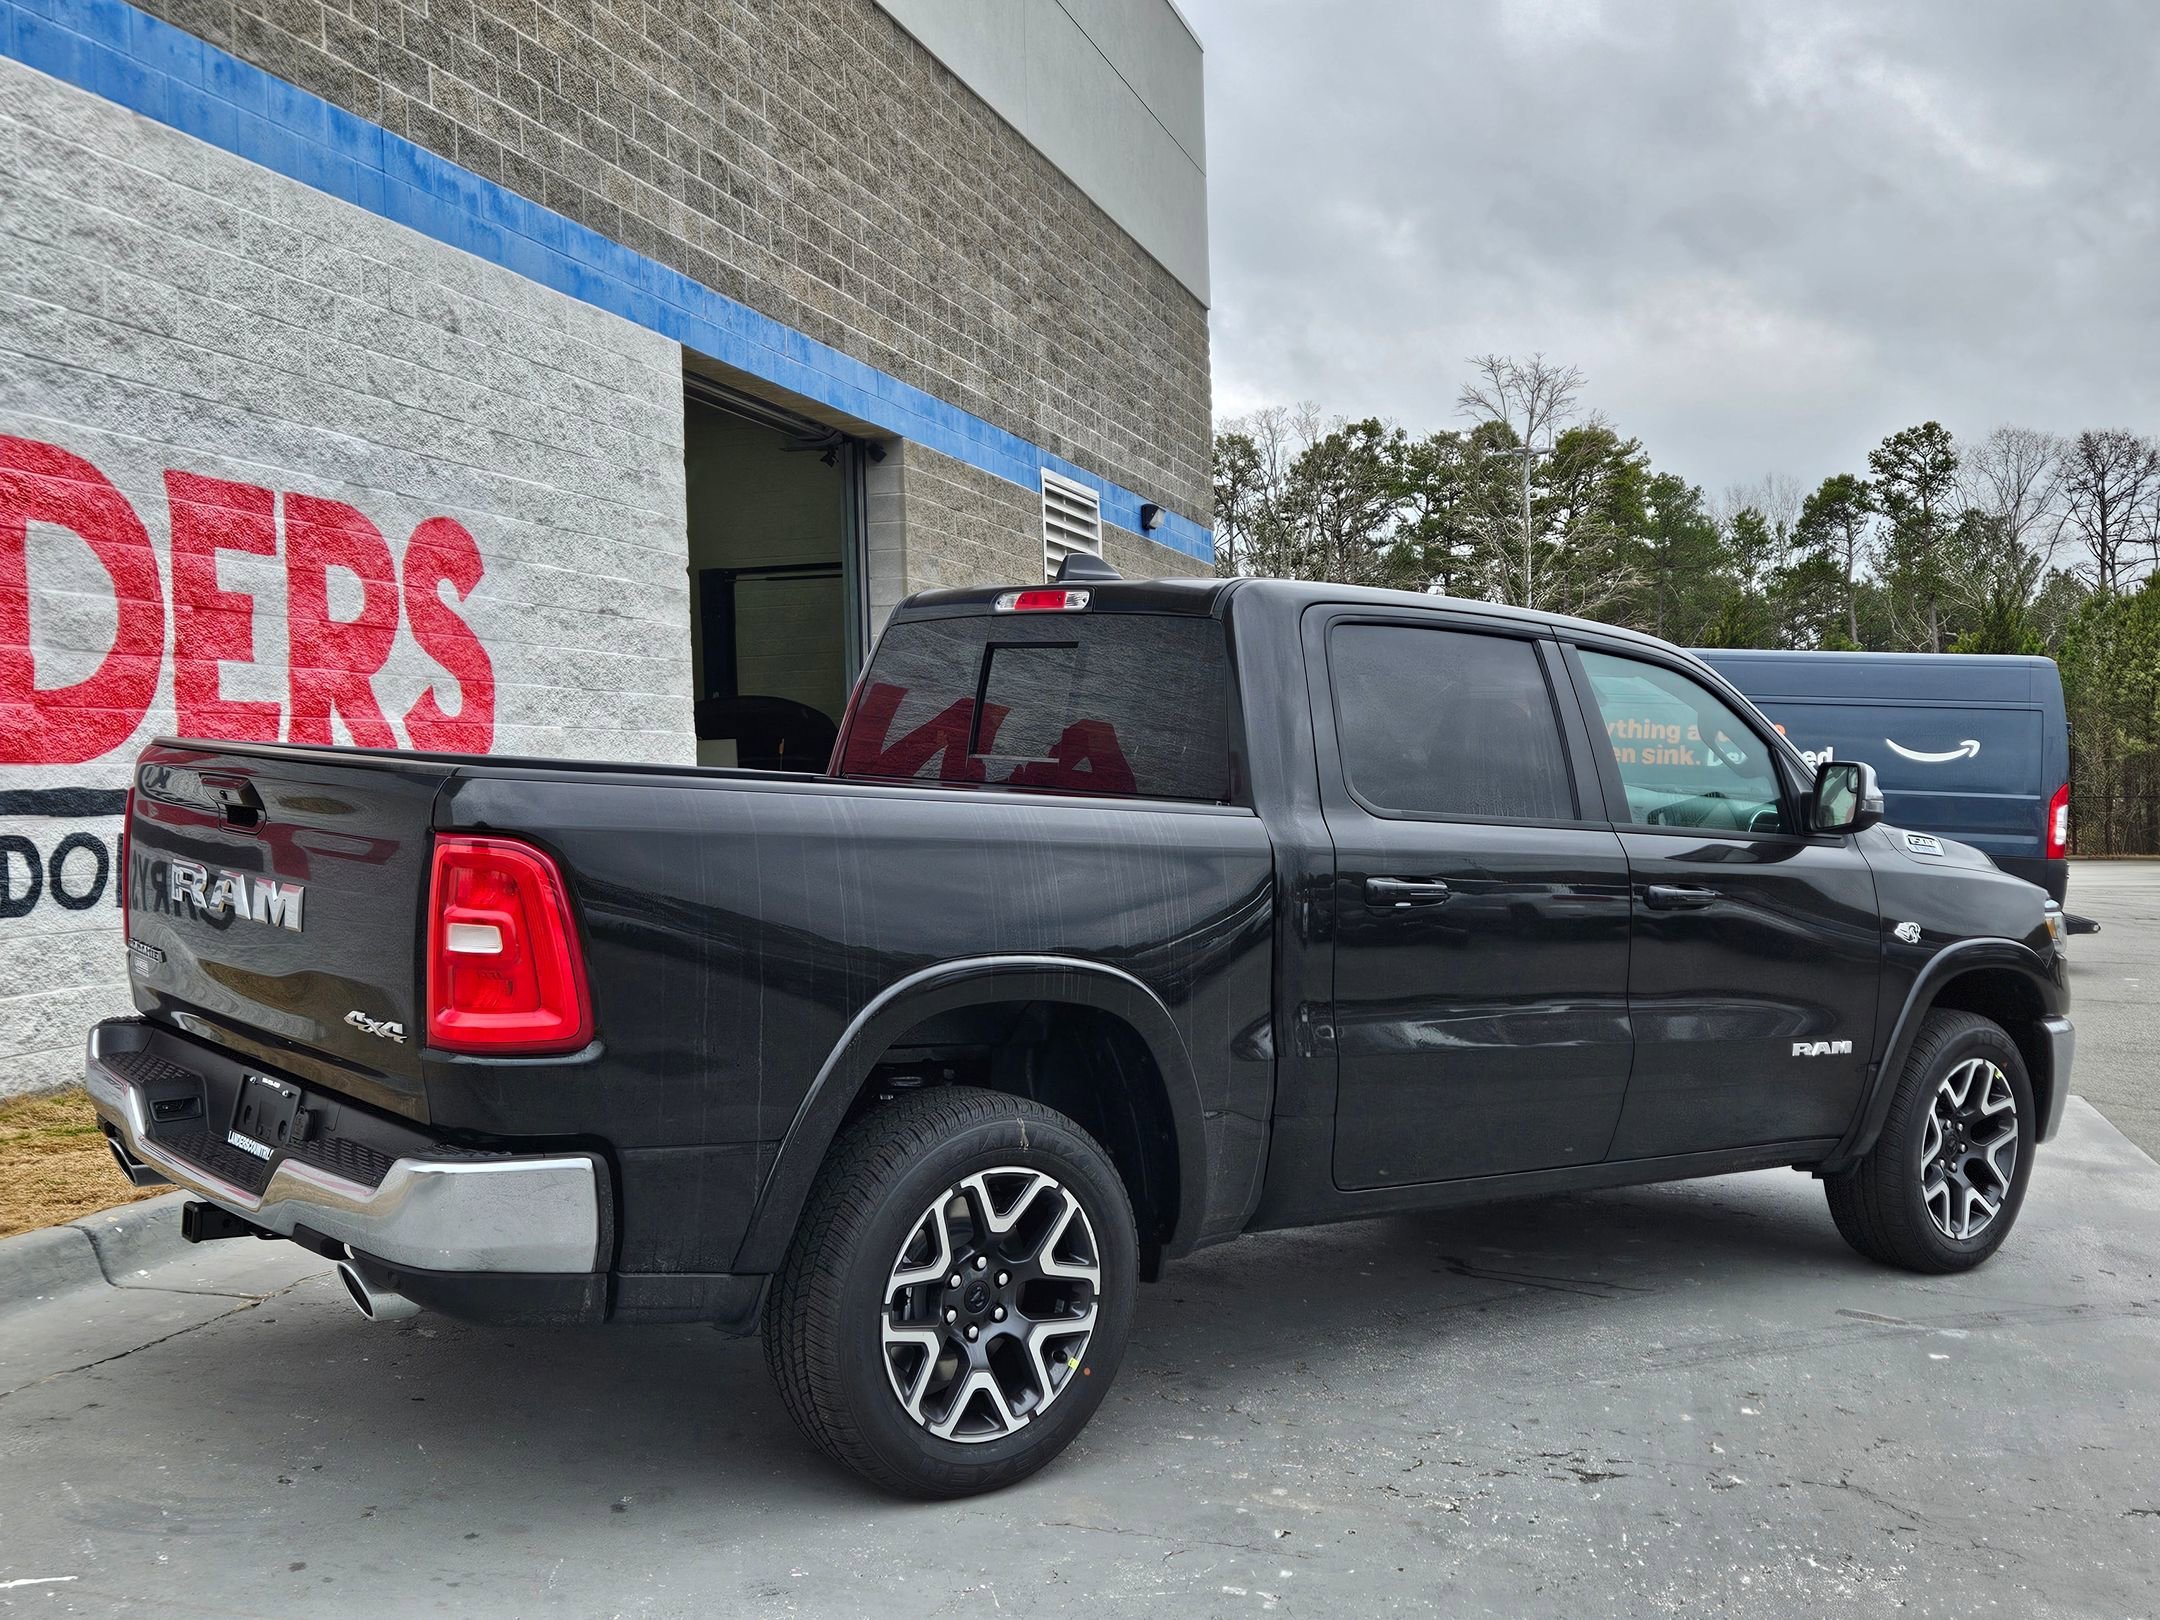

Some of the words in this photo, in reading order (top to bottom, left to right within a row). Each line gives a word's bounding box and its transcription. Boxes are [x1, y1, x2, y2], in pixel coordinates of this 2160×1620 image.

[0, 435, 495, 765] DERS
[1641, 744, 1701, 765] sink.
[171, 858, 305, 933] RAM
[1792, 1040, 1853, 1057] RAM
